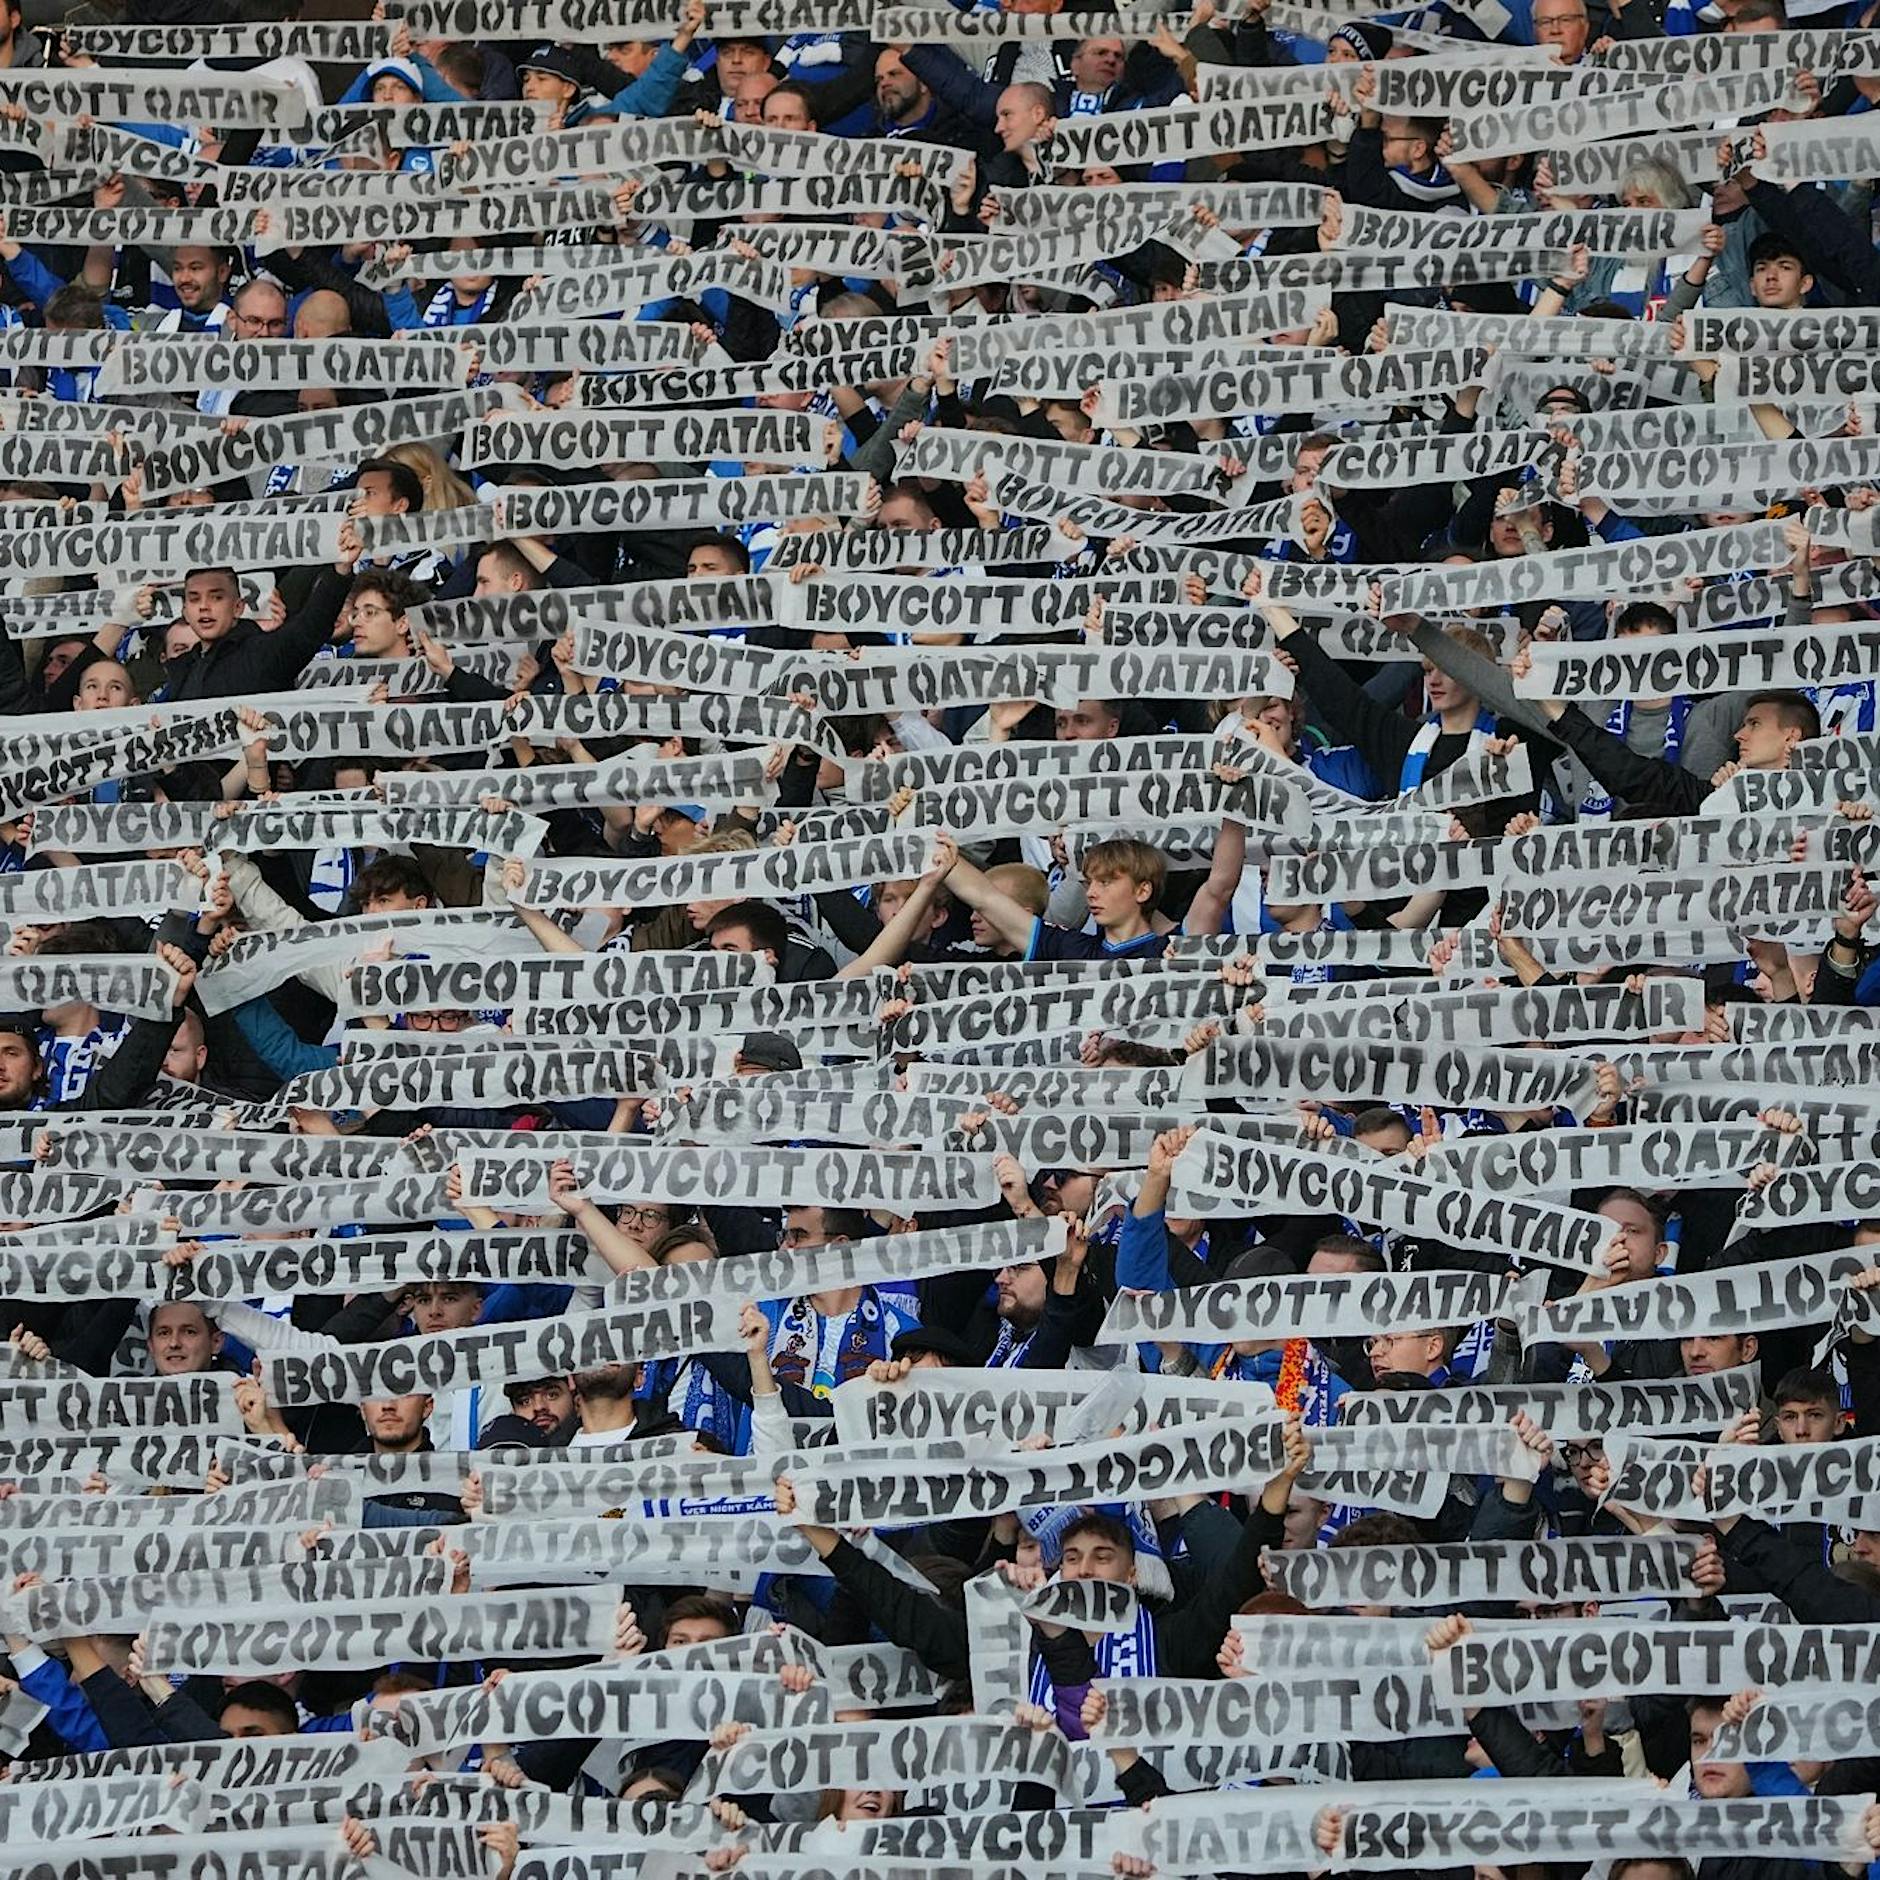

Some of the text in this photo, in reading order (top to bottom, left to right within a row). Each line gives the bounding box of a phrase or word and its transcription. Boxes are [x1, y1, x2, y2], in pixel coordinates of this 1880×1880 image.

[256, 25, 390, 57] QATAR
[1598, 38, 1775, 72] OYCOTT
[144, 87, 279, 123] QATAR
[1380, 68, 1572, 107] BOYCOTT
[403, 105, 535, 142] QATAR
[1211, 96, 1335, 144] QATAR
[1451, 92, 1643, 150] BOYCOTT
[436, 130, 611, 190] BOYCOTT
[824, 138, 952, 180] QATAR
[223, 171, 405, 200] BOYCOTT
[632, 176, 795, 213] OYCOTT
[8, 208, 203, 240] BOYCOTT
[286, 191, 614, 240] BOYCOTT QATAR
[1353, 212, 1677, 251] BOYCOTT QATAR
[667, 250, 785, 296] QATAR
[953, 290, 1307, 373] BOYCOTT QATAR
[1390, 315, 1602, 353] BOYCOTT
[123, 345, 315, 384] BOYCOTT
[325, 343, 455, 381] QATAR
[583, 347, 916, 405] BOYCOTT QATAR
[1119, 362, 1331, 420] BOYCOTT
[1341, 348, 1487, 400] QATAR
[1740, 358, 1880, 397] BOYC
[145, 388, 500, 488] BOYCOTT QATAR
[473, 416, 811, 461] BOYCOTT QATAR
[903, 440, 1092, 486] BOYCOTT
[1576, 438, 1880, 488] BOYCOTT QAT
[507, 479, 860, 530] BOYCOTT QATAR
[997, 473, 1292, 537] BOYCOTT QATAR
[185, 521, 320, 567] QATAR
[773, 527, 1050, 567] BOYCOTT QATAR
[423, 578, 775, 637] BOYCOTT QATAR
[807, 582, 1025, 625] BOYCOTT
[580, 625, 774, 682] BOYCOTT
[1111, 650, 1270, 697] QATAR
[1555, 640, 1785, 693] BOYCOTT
[125, 710, 240, 762] QATAR
[500, 694, 690, 738] OYCOTT
[607, 758, 763, 804] QATAR
[915, 778, 1130, 830] BOYCOTT
[1138, 773, 1292, 825] QATAR
[30, 804, 205, 847] BOYCOT
[34, 862, 185, 912] QATAR
[525, 835, 928, 905] BOYCOTT QATAR
[1282, 842, 1502, 896] BOYCOTT
[1512, 828, 1682, 874] QATAR
[1502, 886, 1703, 932] BOYCOTT
[13, 964, 172, 1008] QATAR
[350, 955, 762, 1007] BOYCOTT QATAR
[526, 990, 738, 1035] BOYCOTT
[1513, 983, 1687, 1040] QATAR
[278, 1048, 658, 1107] BOYCOTT QATAR
[1205, 1040, 1425, 1097] BOYCOTT
[1435, 1048, 1590, 1104] QATAR
[568, 1148, 976, 1203] BOYCOTT QATAR
[1424, 1130, 1633, 1190] OYCOTT
[1200, 1142, 1602, 1266] BOYCOTT QATAR
[165, 1238, 590, 1300] BOYCOTT QATAR
[615, 1242, 865, 1305] BOYCOTT
[273, 1300, 715, 1406] BOYCOTT QATAR
[57, 1378, 220, 1432] QATAR
[866, 1388, 1080, 1442] BOYCOT
[1578, 1372, 1757, 1434] QATAR
[480, 1458, 758, 1515] BOYCOTT
[1022, 1420, 1284, 1504] BOYCOTT
[710, 1505, 742, 1514] NICHT
[815, 1470, 1008, 1524] QATAR
[280, 1556, 446, 1603] QATAR
[152, 1598, 592, 1667] BOYCOTT QATAR
[1452, 1630, 1735, 1697] BOYCOTT
[1105, 1680, 1360, 1738] BOYCOTT
[30, 1783, 202, 1840] QATAR
[1345, 1797, 1847, 1862] BOYCOTT QATAR
